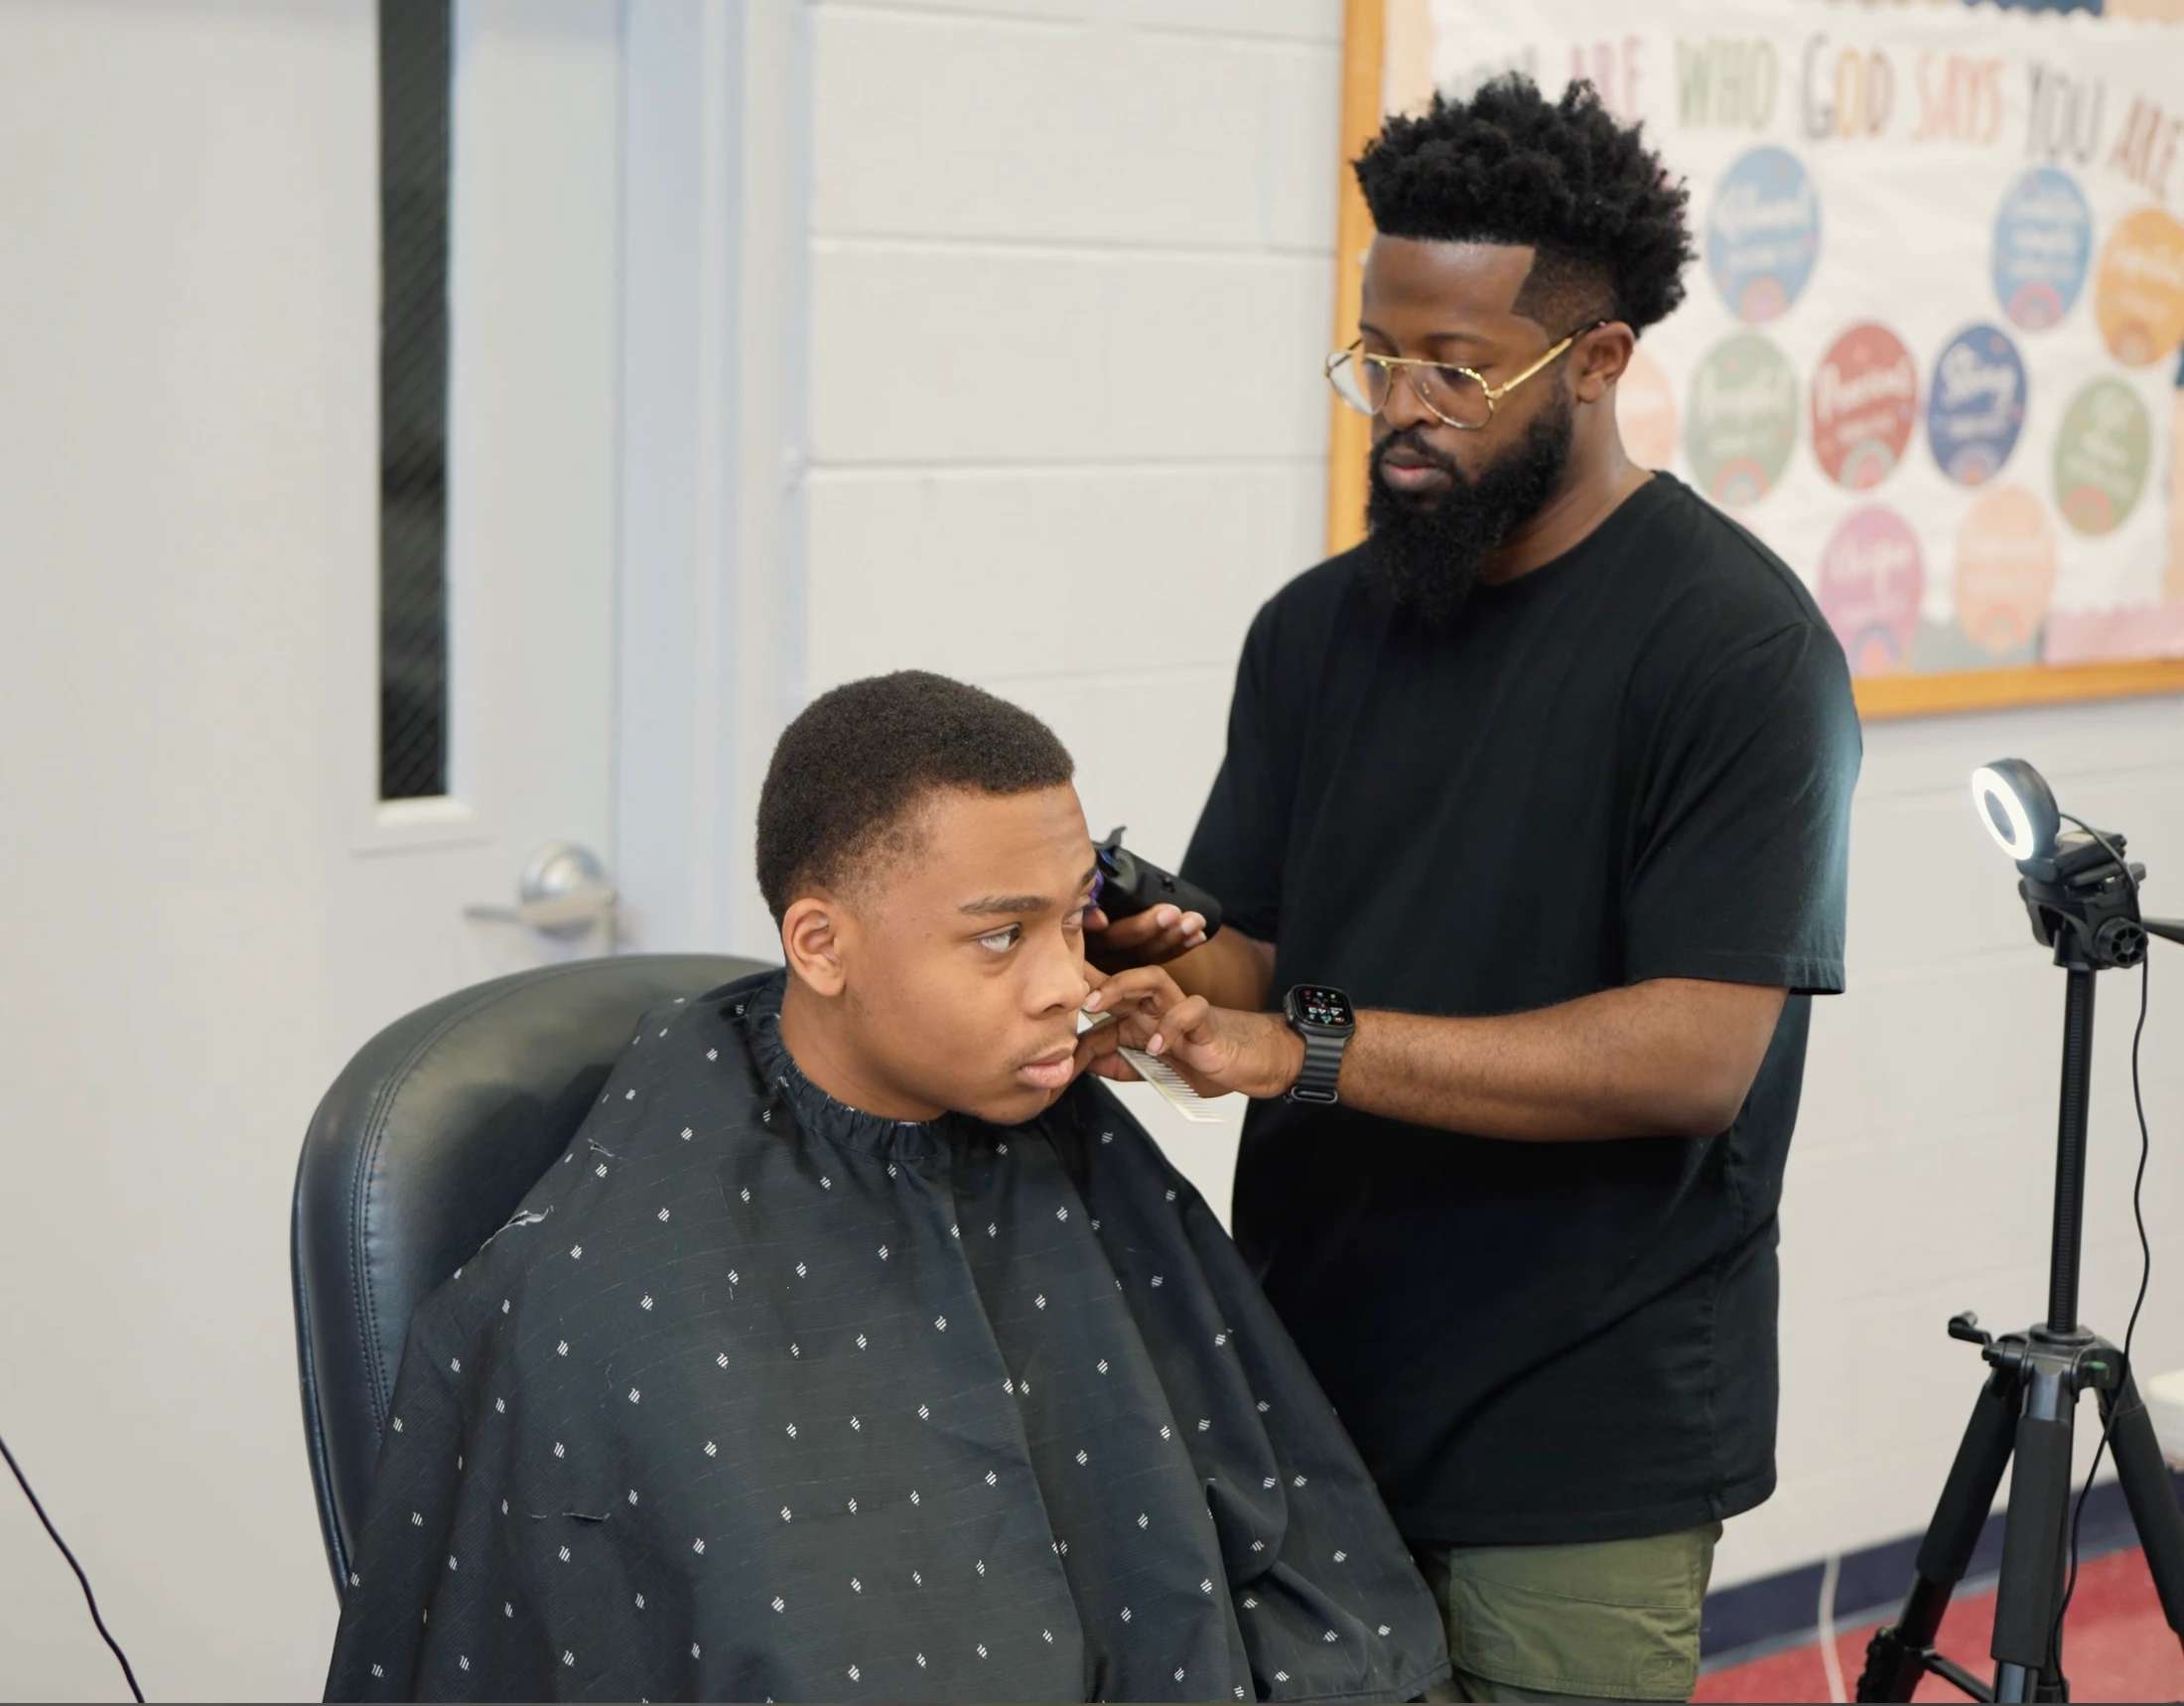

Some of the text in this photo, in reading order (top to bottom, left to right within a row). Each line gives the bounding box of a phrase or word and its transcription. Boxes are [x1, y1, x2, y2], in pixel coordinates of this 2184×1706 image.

[1675, 38, 1780, 130] WHO
[1802, 34, 1896, 140] GOD
[1912, 50, 2005, 145] SAYS
[2028, 62, 2106, 164] YOU
[2107, 95, 2184, 201] ARE
